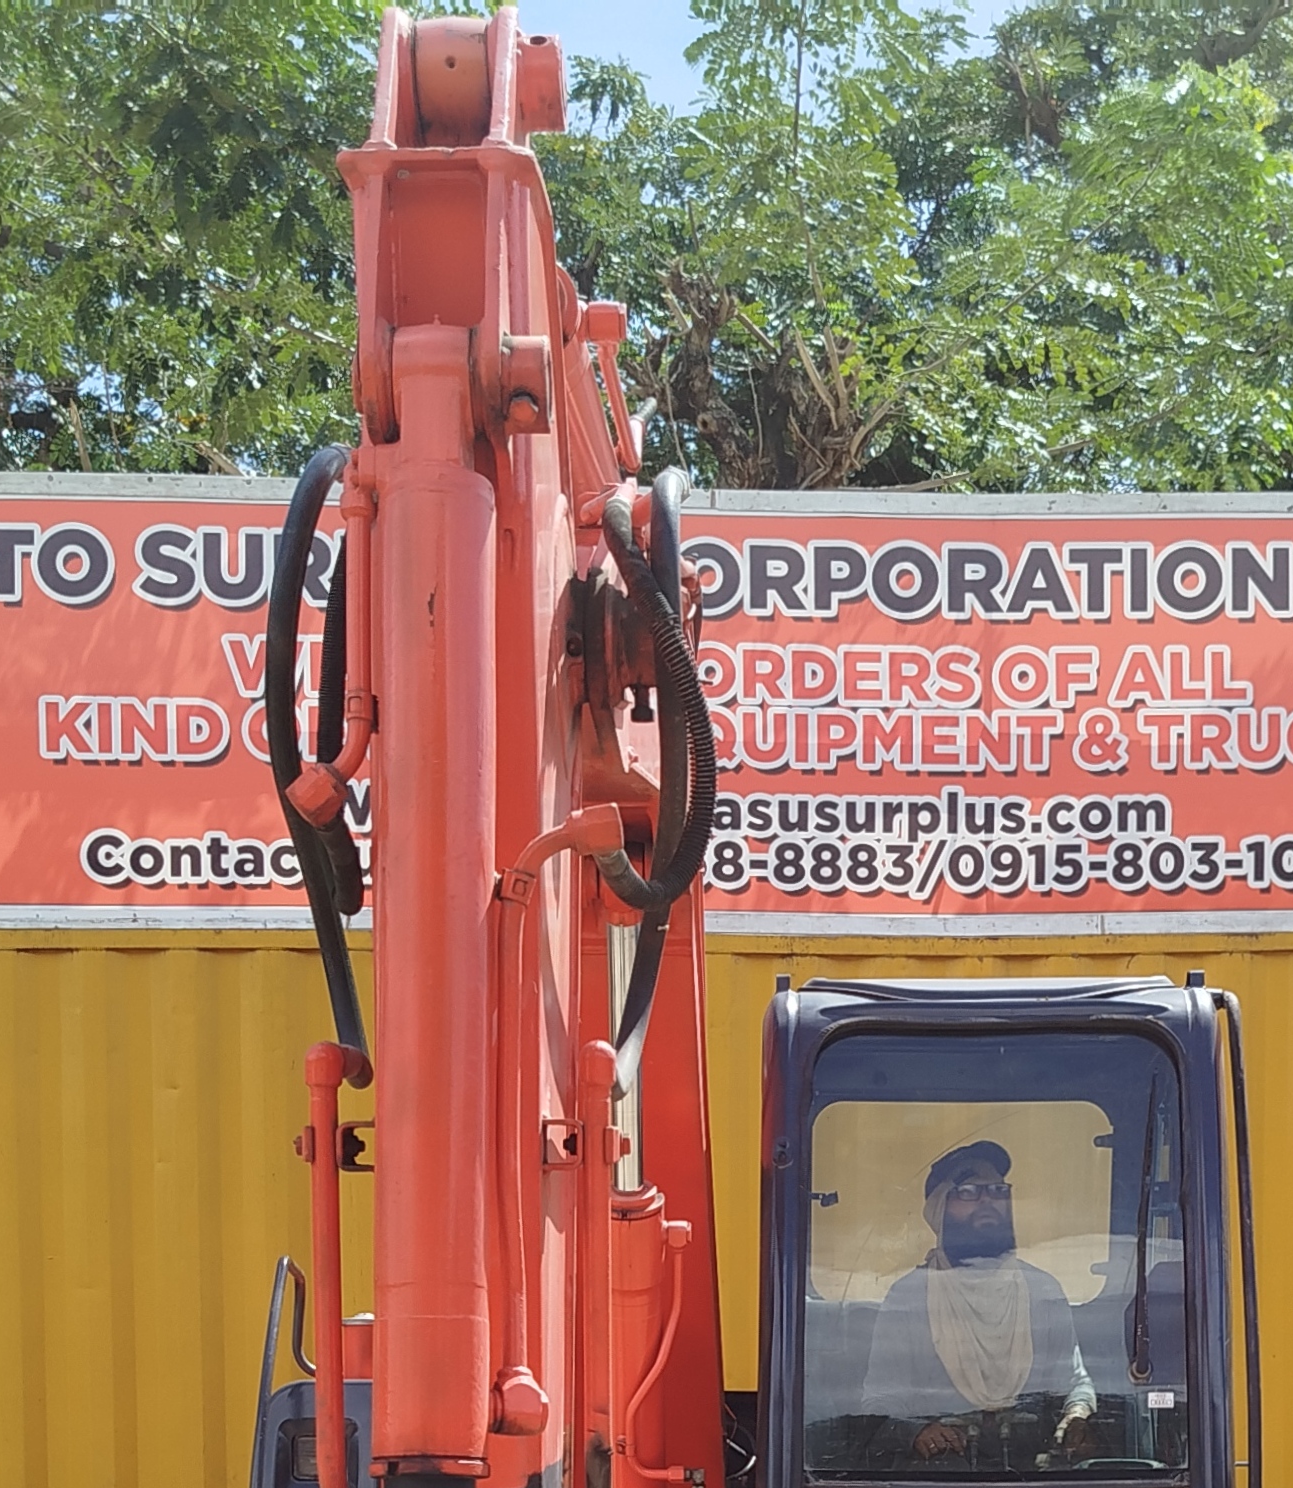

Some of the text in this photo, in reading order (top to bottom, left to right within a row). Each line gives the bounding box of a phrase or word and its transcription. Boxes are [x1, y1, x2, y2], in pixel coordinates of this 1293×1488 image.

[137, 526, 338, 604] SUR
[681, 541, 1293, 616] ORPORATION
[700, 645, 977, 705] ORDERS
[995, 648, 1096, 705] OF
[1110, 647, 1249, 704] ALL
[41, 698, 227, 760] KIND
[711, 711, 1056, 770] QUIPMENT
[1075, 711, 1126, 769] &
[714, 791, 1167, 840] asusurplus.com
[84, 832, 298, 882] Contac
